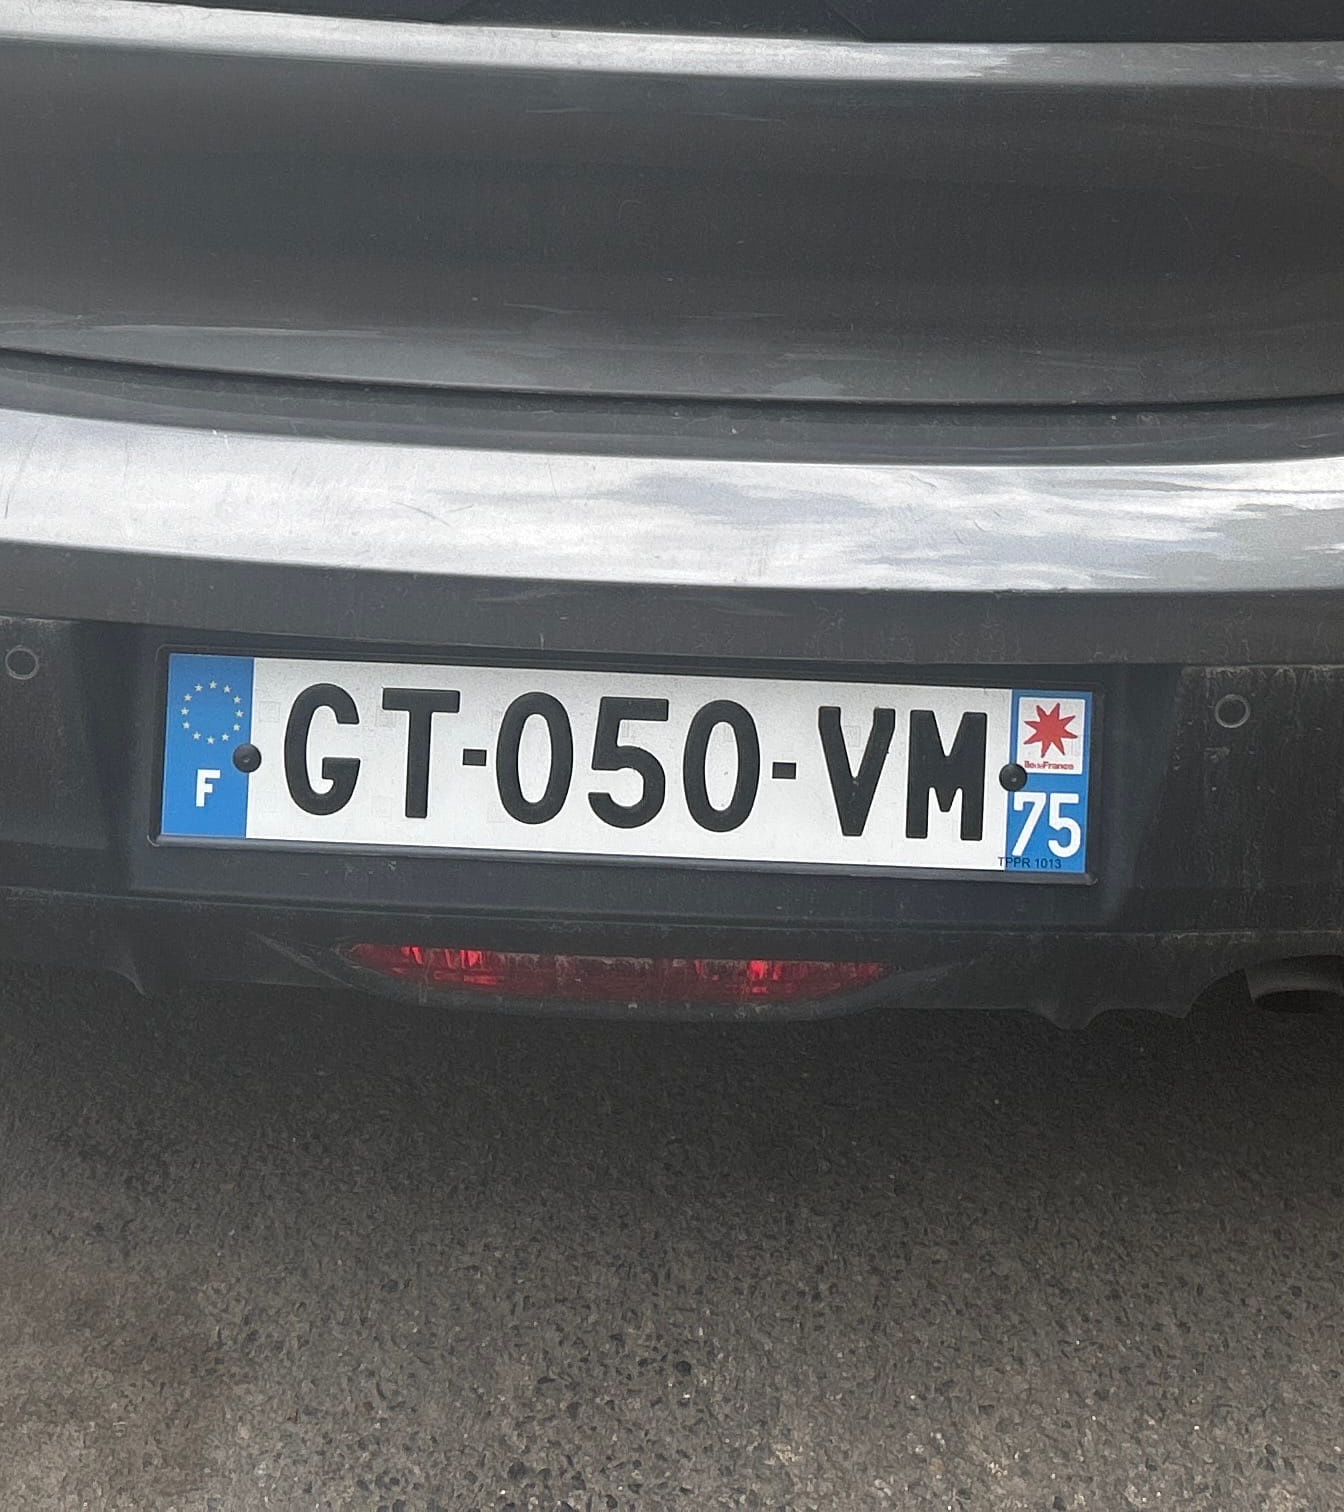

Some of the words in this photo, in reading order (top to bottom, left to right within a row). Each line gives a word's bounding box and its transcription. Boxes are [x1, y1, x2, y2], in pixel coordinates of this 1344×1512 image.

[195, 769, 221, 808] F
[283, 683, 988, 842] GT-050-VM
[1011, 791, 1081, 858] 75
[998, 856, 1031, 869] TPPR
[1035, 857, 1062, 869] 1013
